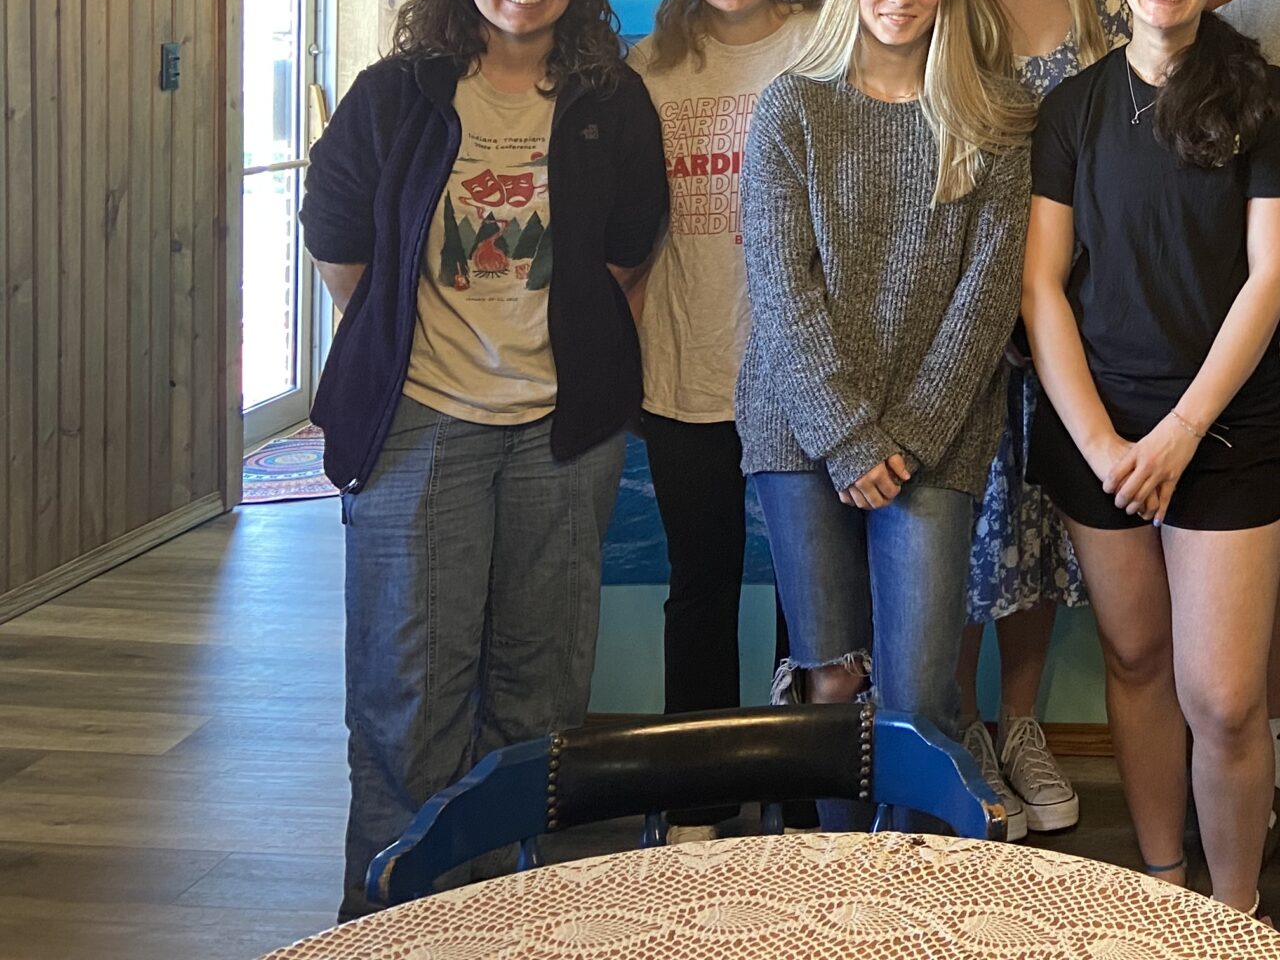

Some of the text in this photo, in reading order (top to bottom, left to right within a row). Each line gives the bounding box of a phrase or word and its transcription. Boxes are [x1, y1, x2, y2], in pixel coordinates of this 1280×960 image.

[662, 113, 752, 140] CARDI
[666, 152, 745, 177] ARDI
[672, 173, 740, 197] ARDI
[672, 192, 742, 216] ARDI
